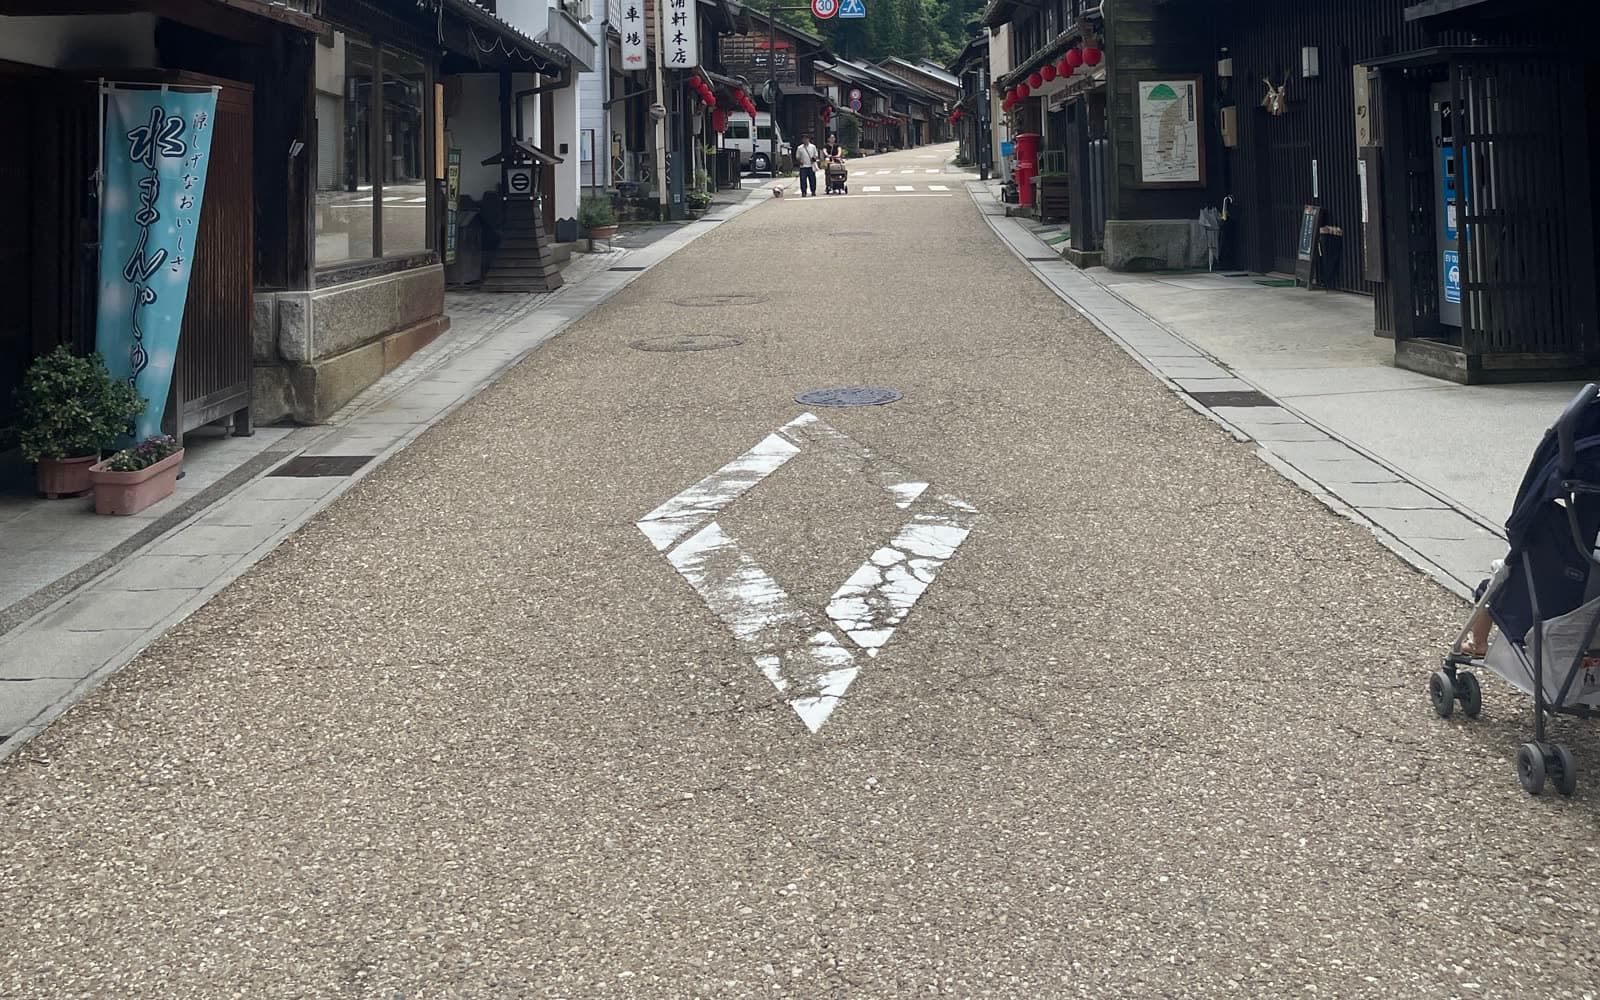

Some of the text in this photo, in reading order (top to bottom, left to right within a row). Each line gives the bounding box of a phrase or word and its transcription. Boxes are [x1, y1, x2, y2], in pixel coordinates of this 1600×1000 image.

[818, 0, 832, 11] 30
[123, 105, 188, 392] 水まんじゅ
[170, 111, 208, 273] 涼しげなおいしさ
